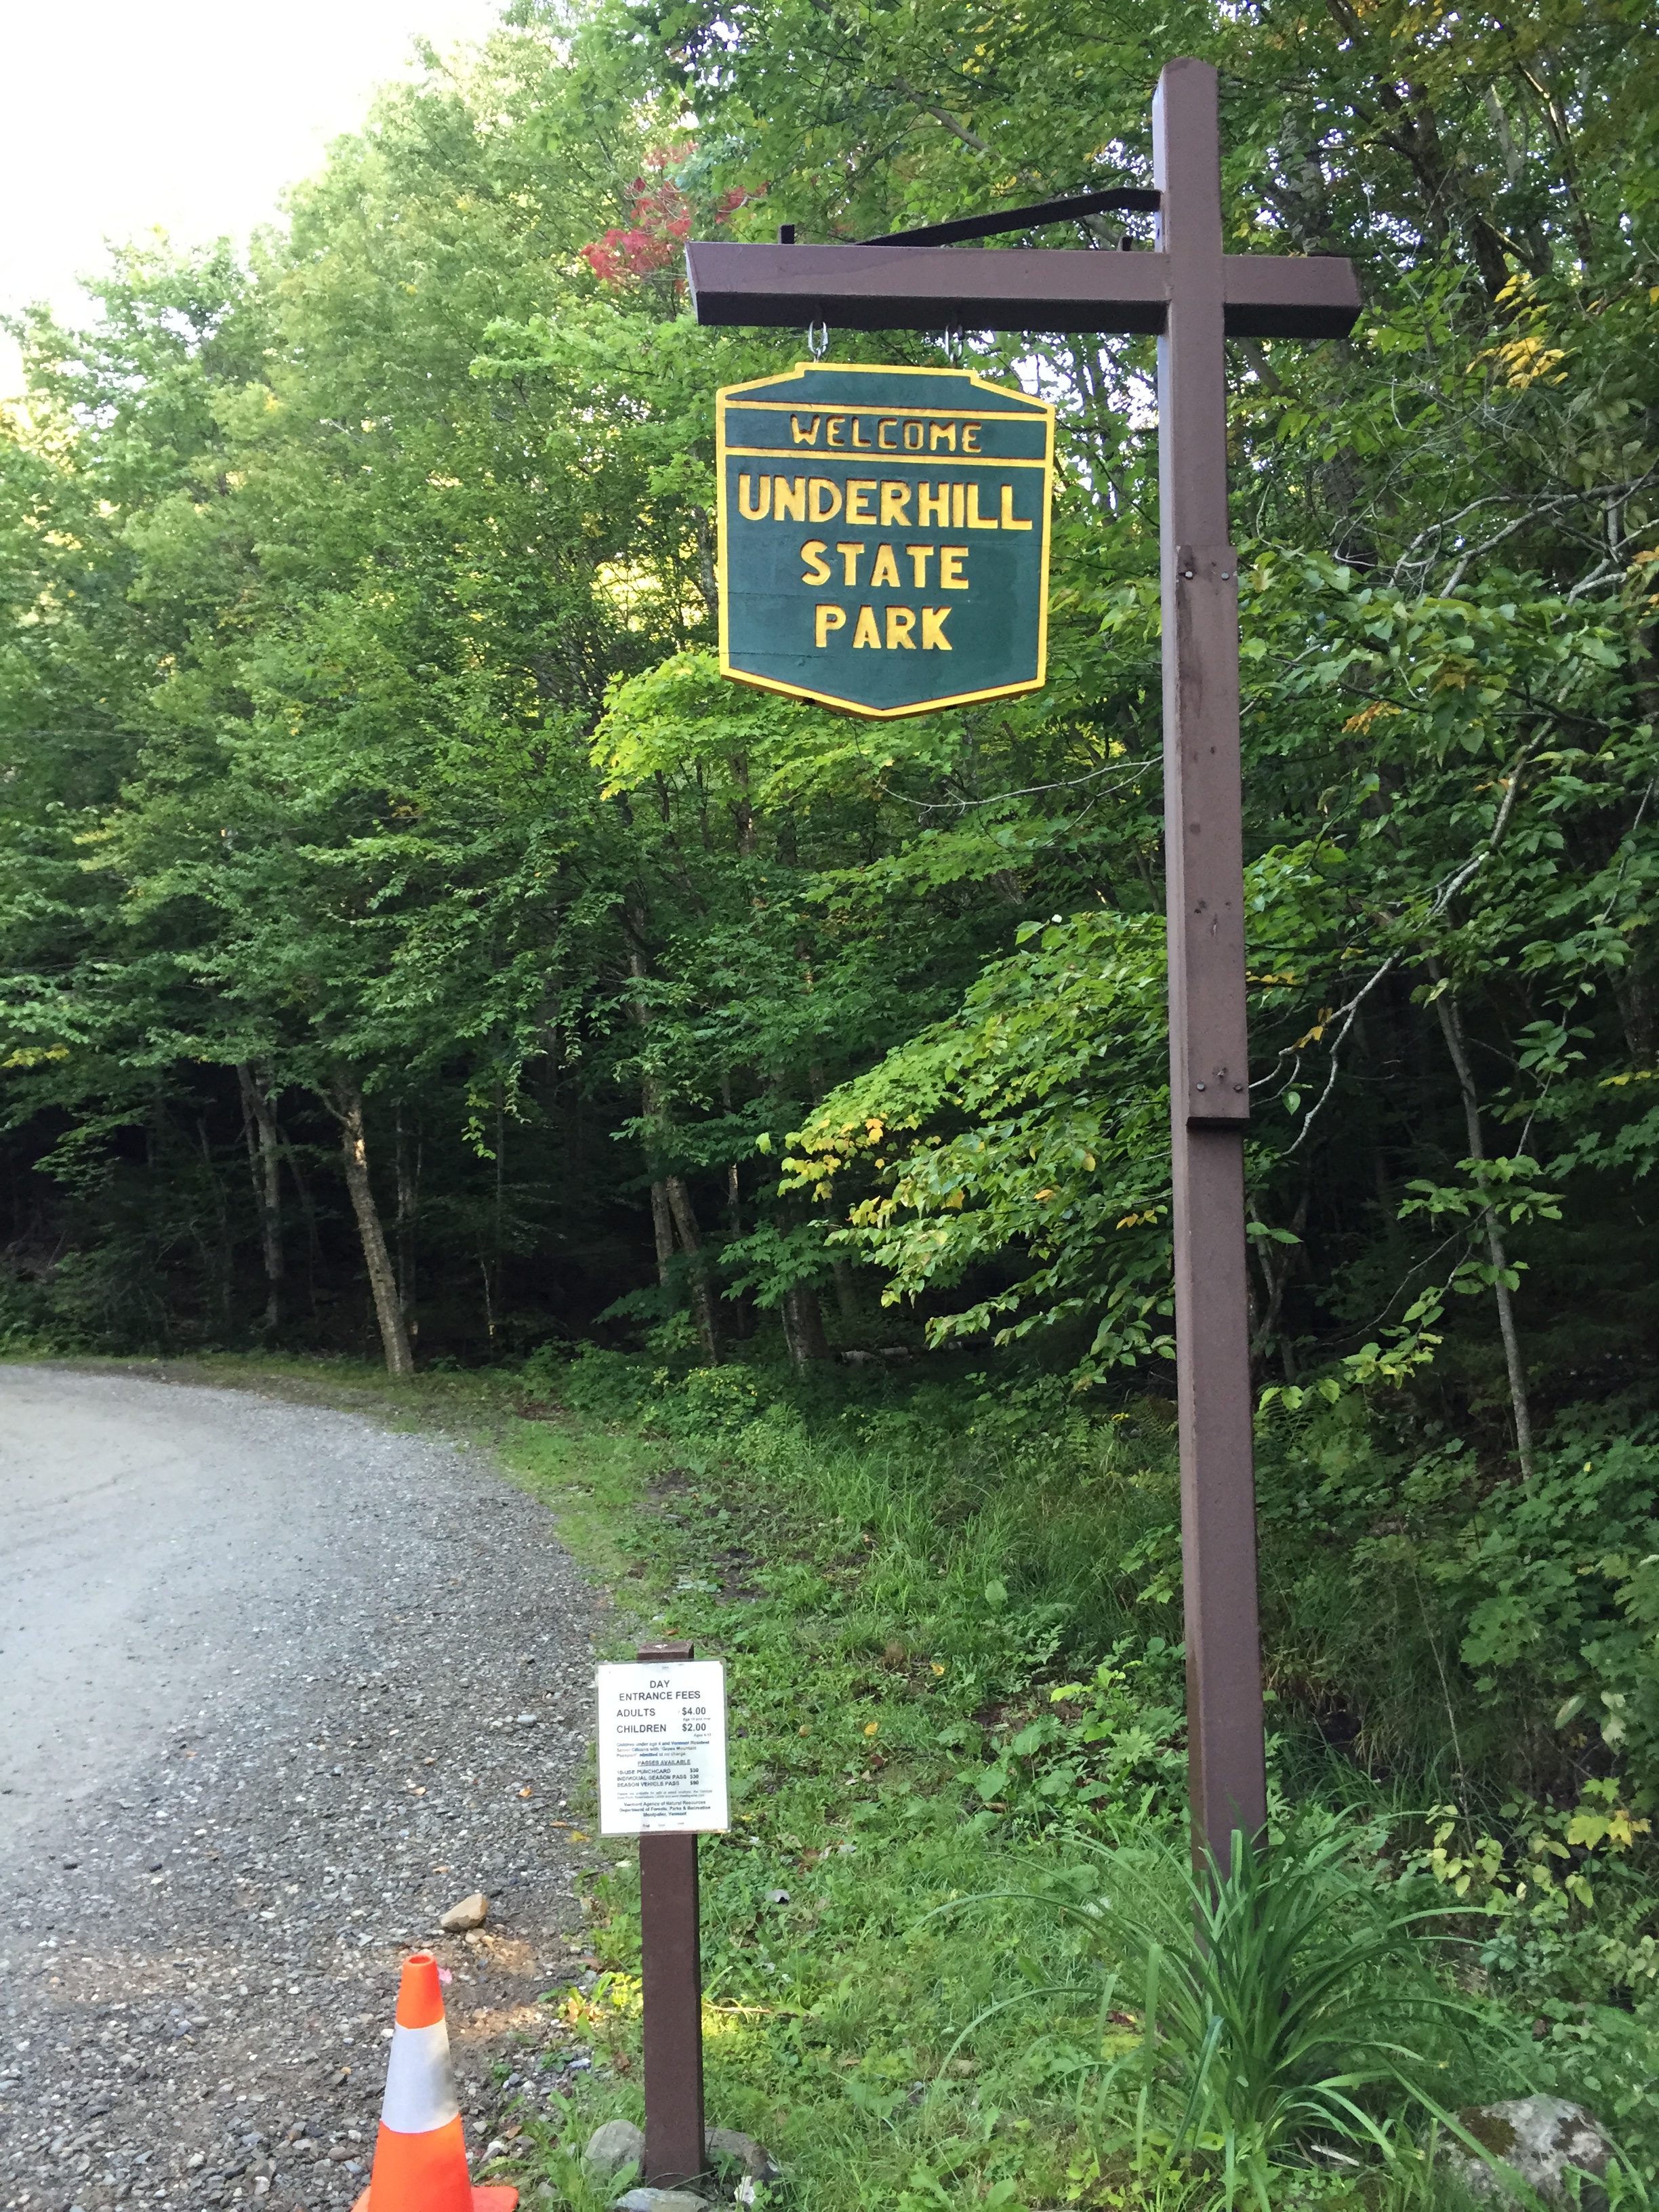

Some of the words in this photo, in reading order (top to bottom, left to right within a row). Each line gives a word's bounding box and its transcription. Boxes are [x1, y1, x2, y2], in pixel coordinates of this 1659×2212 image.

[790, 414, 981, 453] WELCOME
[738, 473, 1032, 530] UNDERHILL
[800, 539, 969, 589] STATE
[815, 604, 952, 650] PARK
[619, 1692, 672, 1701] ENTRANCE
[676, 1691, 701, 1699] FEES
[649, 1680, 670, 1689] DAY
[617, 1708, 656, 1717] ADULTS
[682, 1707, 706, 1716] $4.00
[617, 1724, 666, 1733] CHILDREN
[682, 1723, 706, 1732] $2.00
